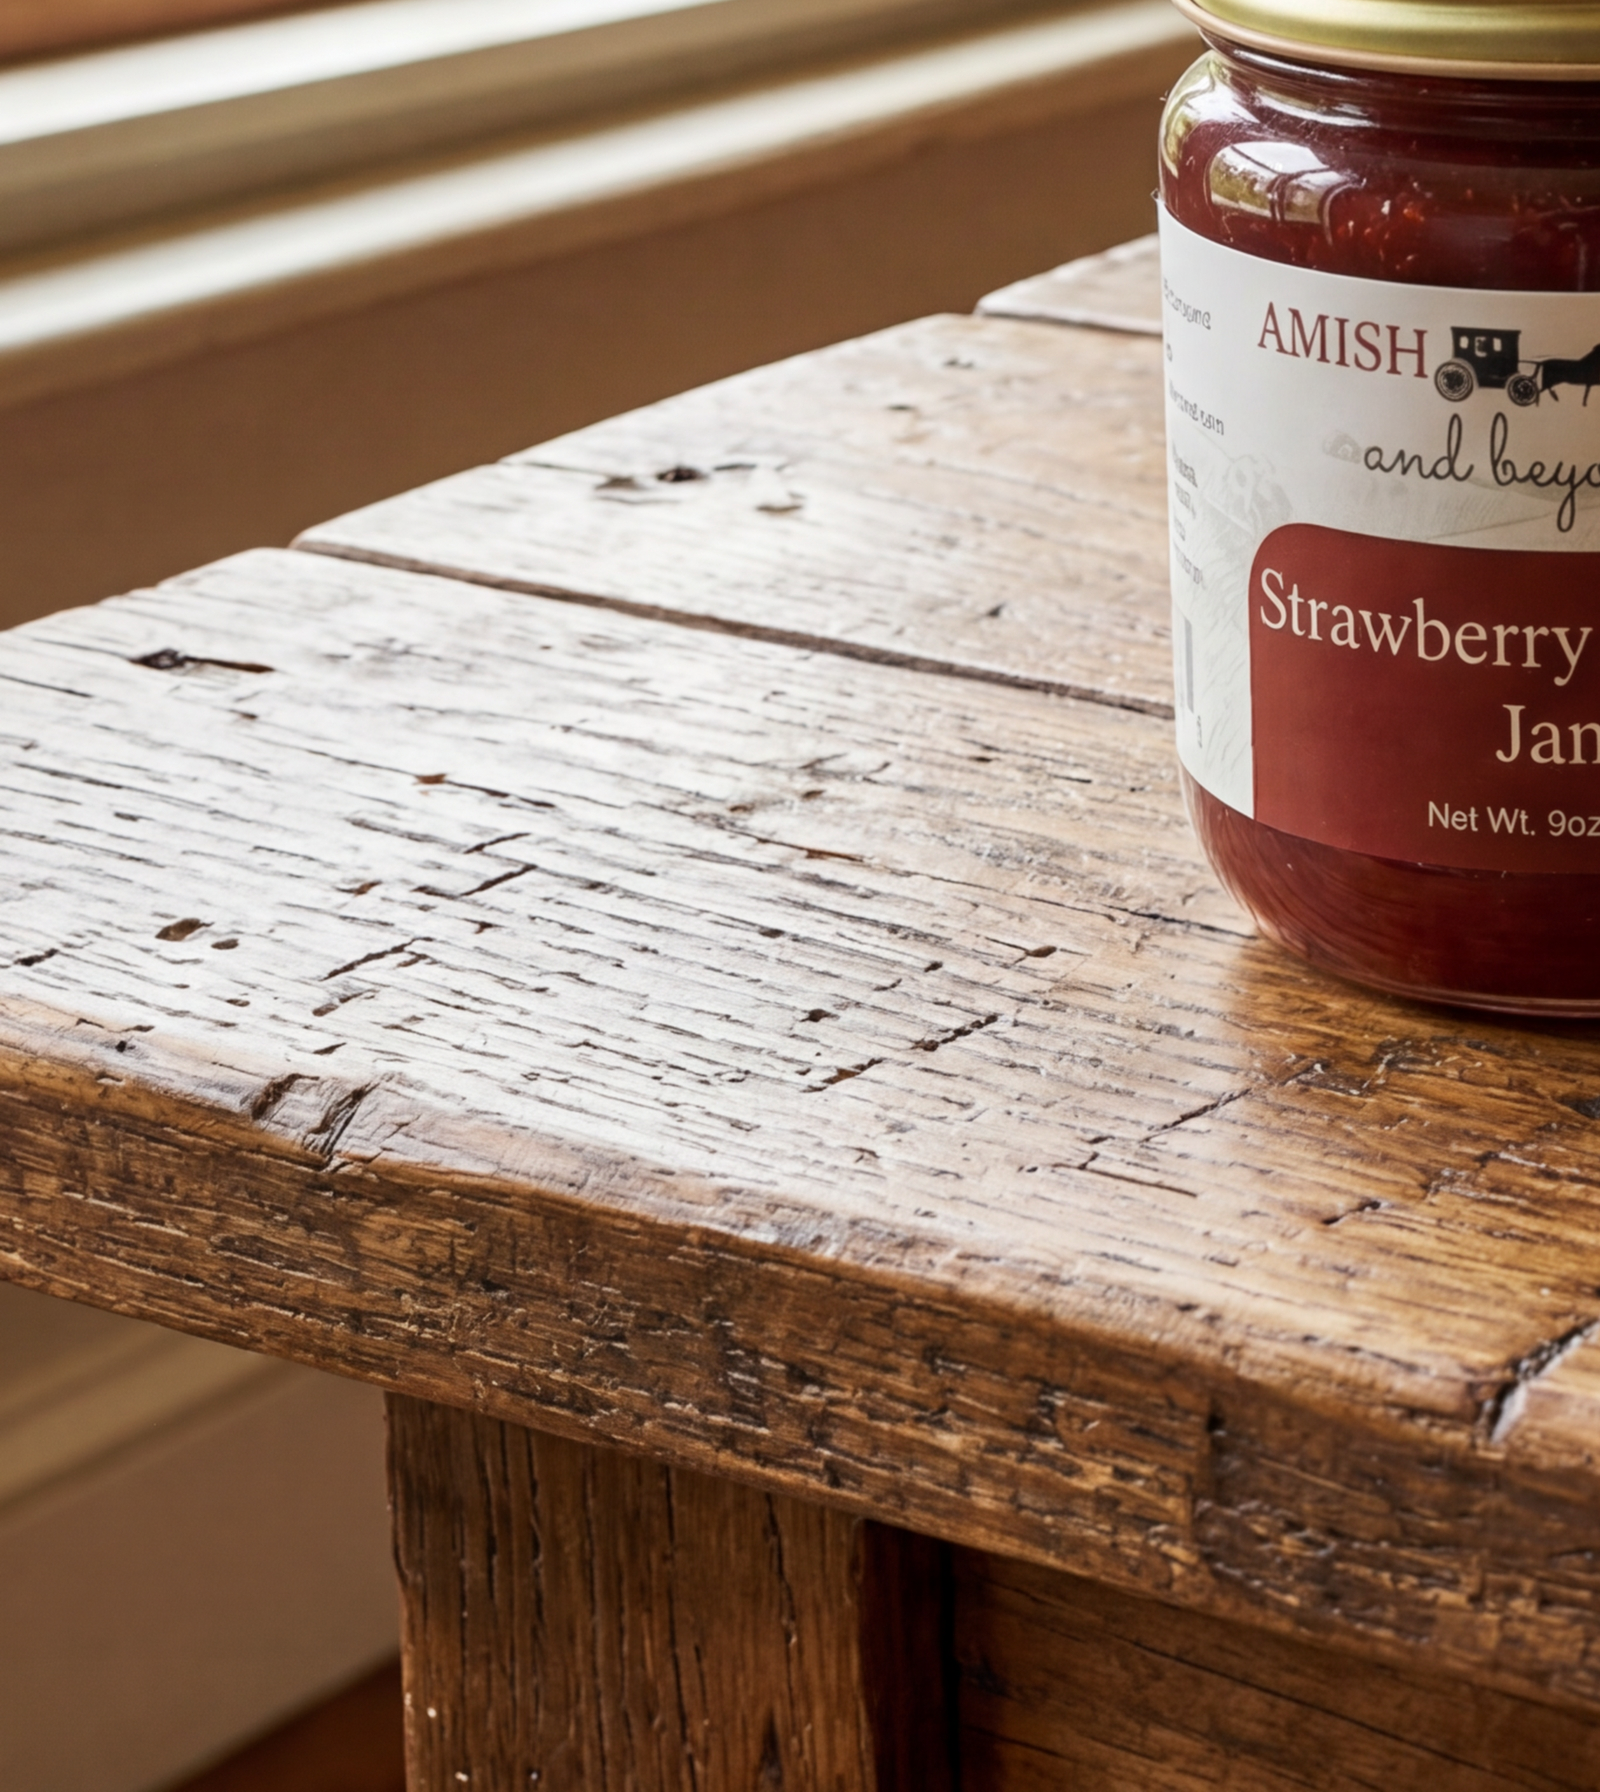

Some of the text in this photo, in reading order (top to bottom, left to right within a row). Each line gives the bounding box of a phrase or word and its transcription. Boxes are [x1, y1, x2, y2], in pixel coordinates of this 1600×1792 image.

[1257, 302, 1429, 379] AMISH
[1363, 412, 1474, 483] and
[1259, 567, 1593, 686] Strawberry
[1427, 800, 1480, 833] Net
[1486, 805, 1536, 837] Wt.
